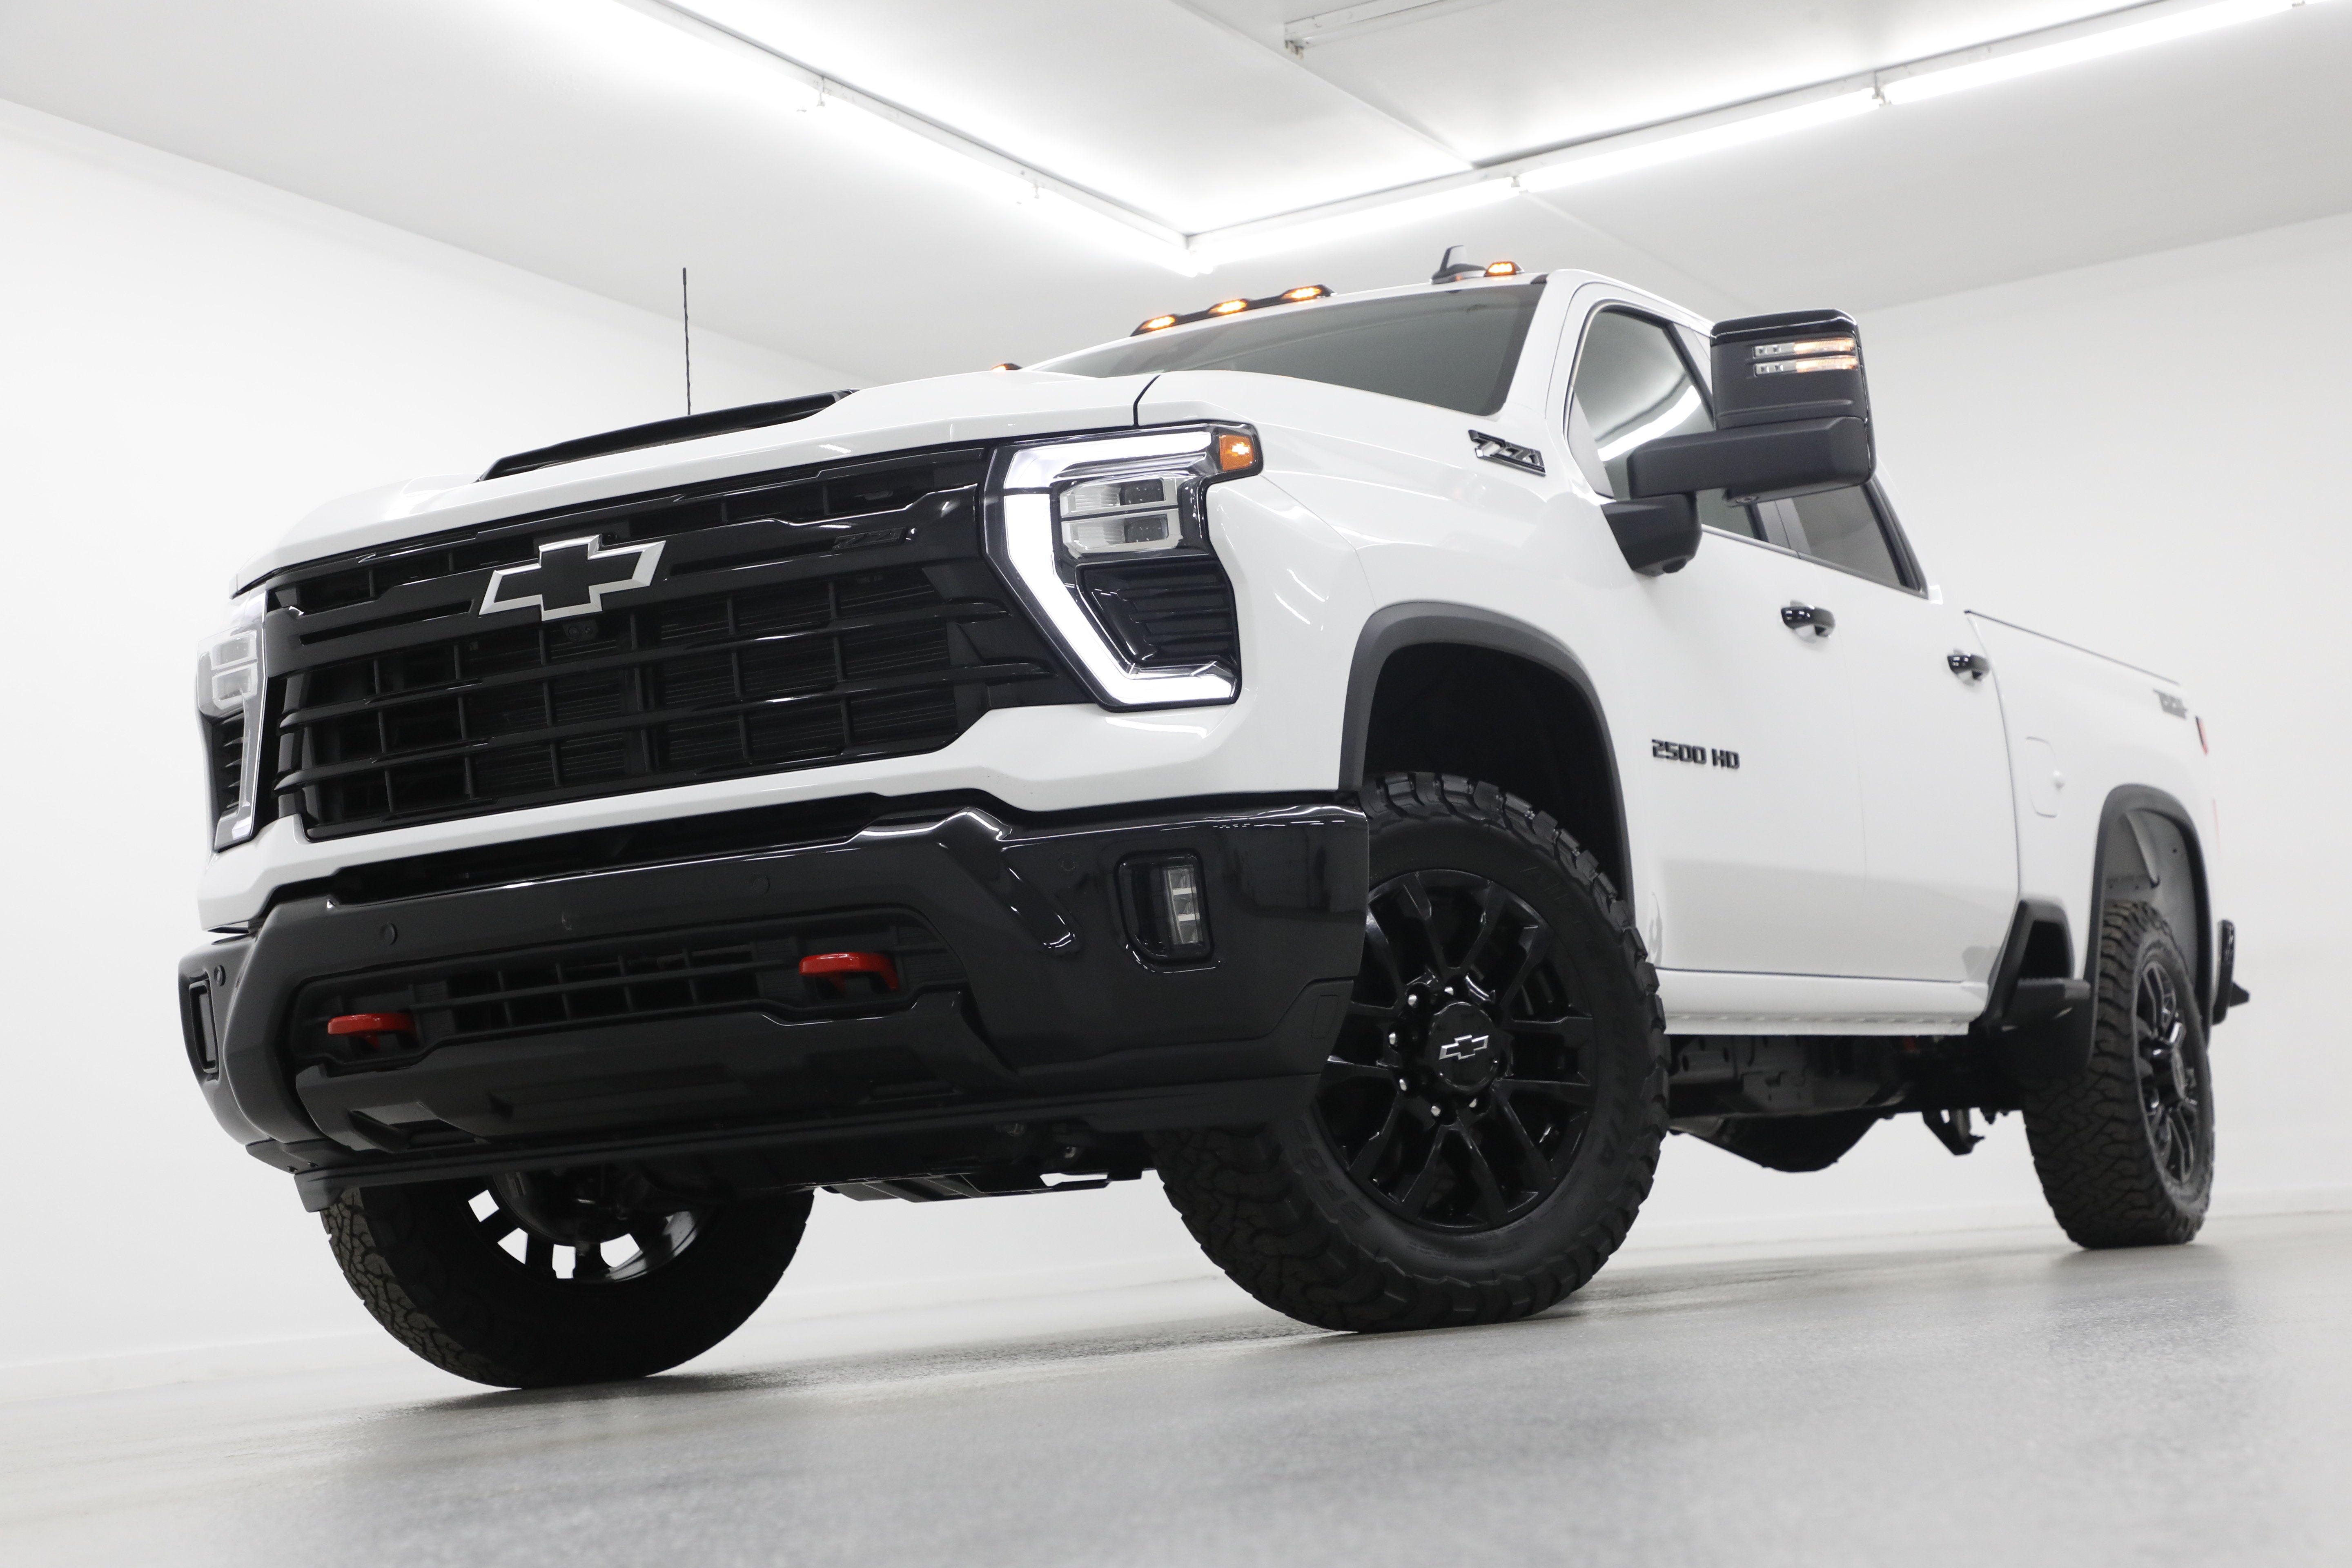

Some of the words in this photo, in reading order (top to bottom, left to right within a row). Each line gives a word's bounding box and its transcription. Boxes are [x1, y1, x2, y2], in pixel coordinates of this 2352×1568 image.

[1468, 429, 1546, 477] Z71
[1652, 739, 1707, 764] 2500
[1711, 748, 1740, 769] HD
